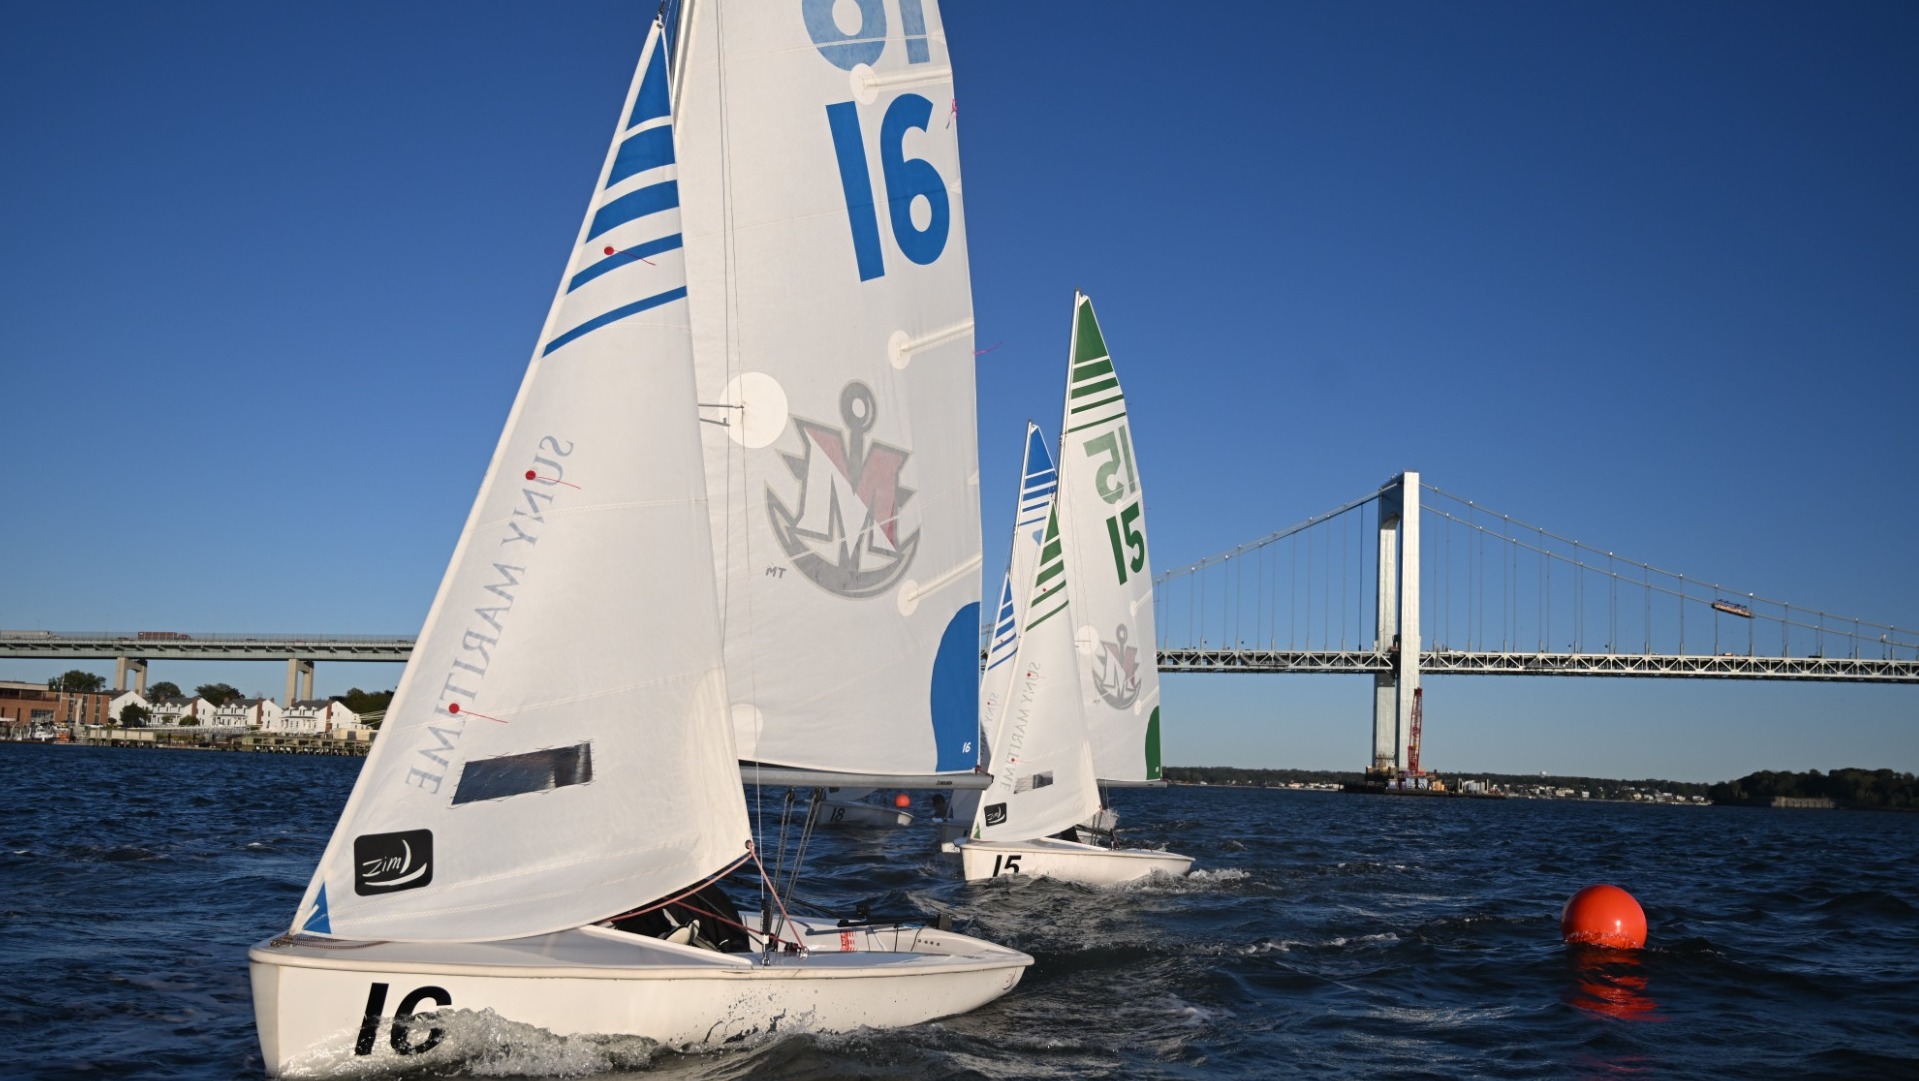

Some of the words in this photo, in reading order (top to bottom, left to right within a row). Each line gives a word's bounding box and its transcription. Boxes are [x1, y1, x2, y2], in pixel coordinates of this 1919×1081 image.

[825, 93, 950, 282] 16
[1106, 501, 1145, 586] 15
[962, 741, 972, 753] 16
[830, 806, 845, 822] 18
[992, 854, 1022, 878] 15
[355, 982, 452, 1056] 16
